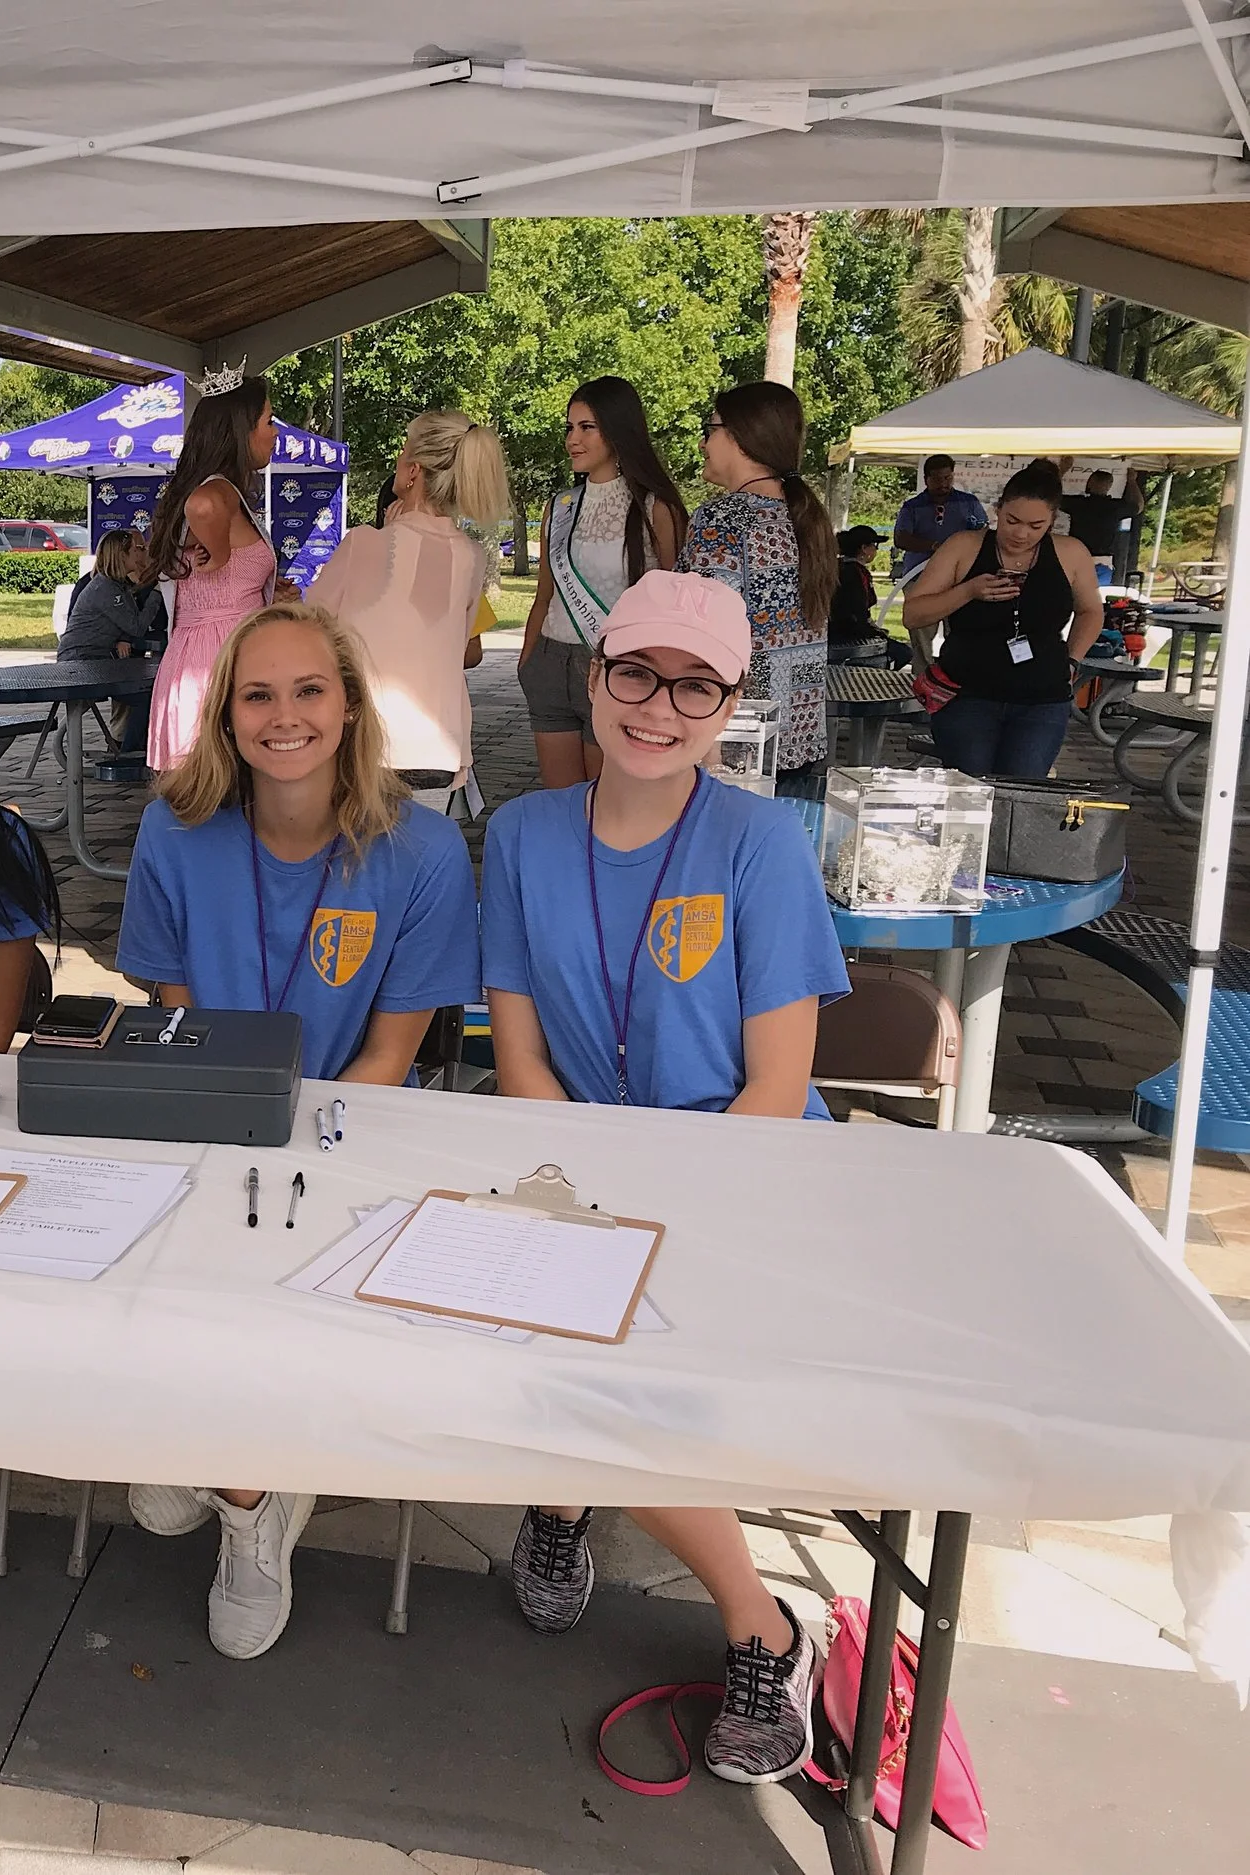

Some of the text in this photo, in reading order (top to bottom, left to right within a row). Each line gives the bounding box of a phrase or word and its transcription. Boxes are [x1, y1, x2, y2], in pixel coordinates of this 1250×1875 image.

[562, 571, 600, 634] Sunshine
[685, 911, 716, 921] AMSA
[342, 925, 370, 935] AMSA
